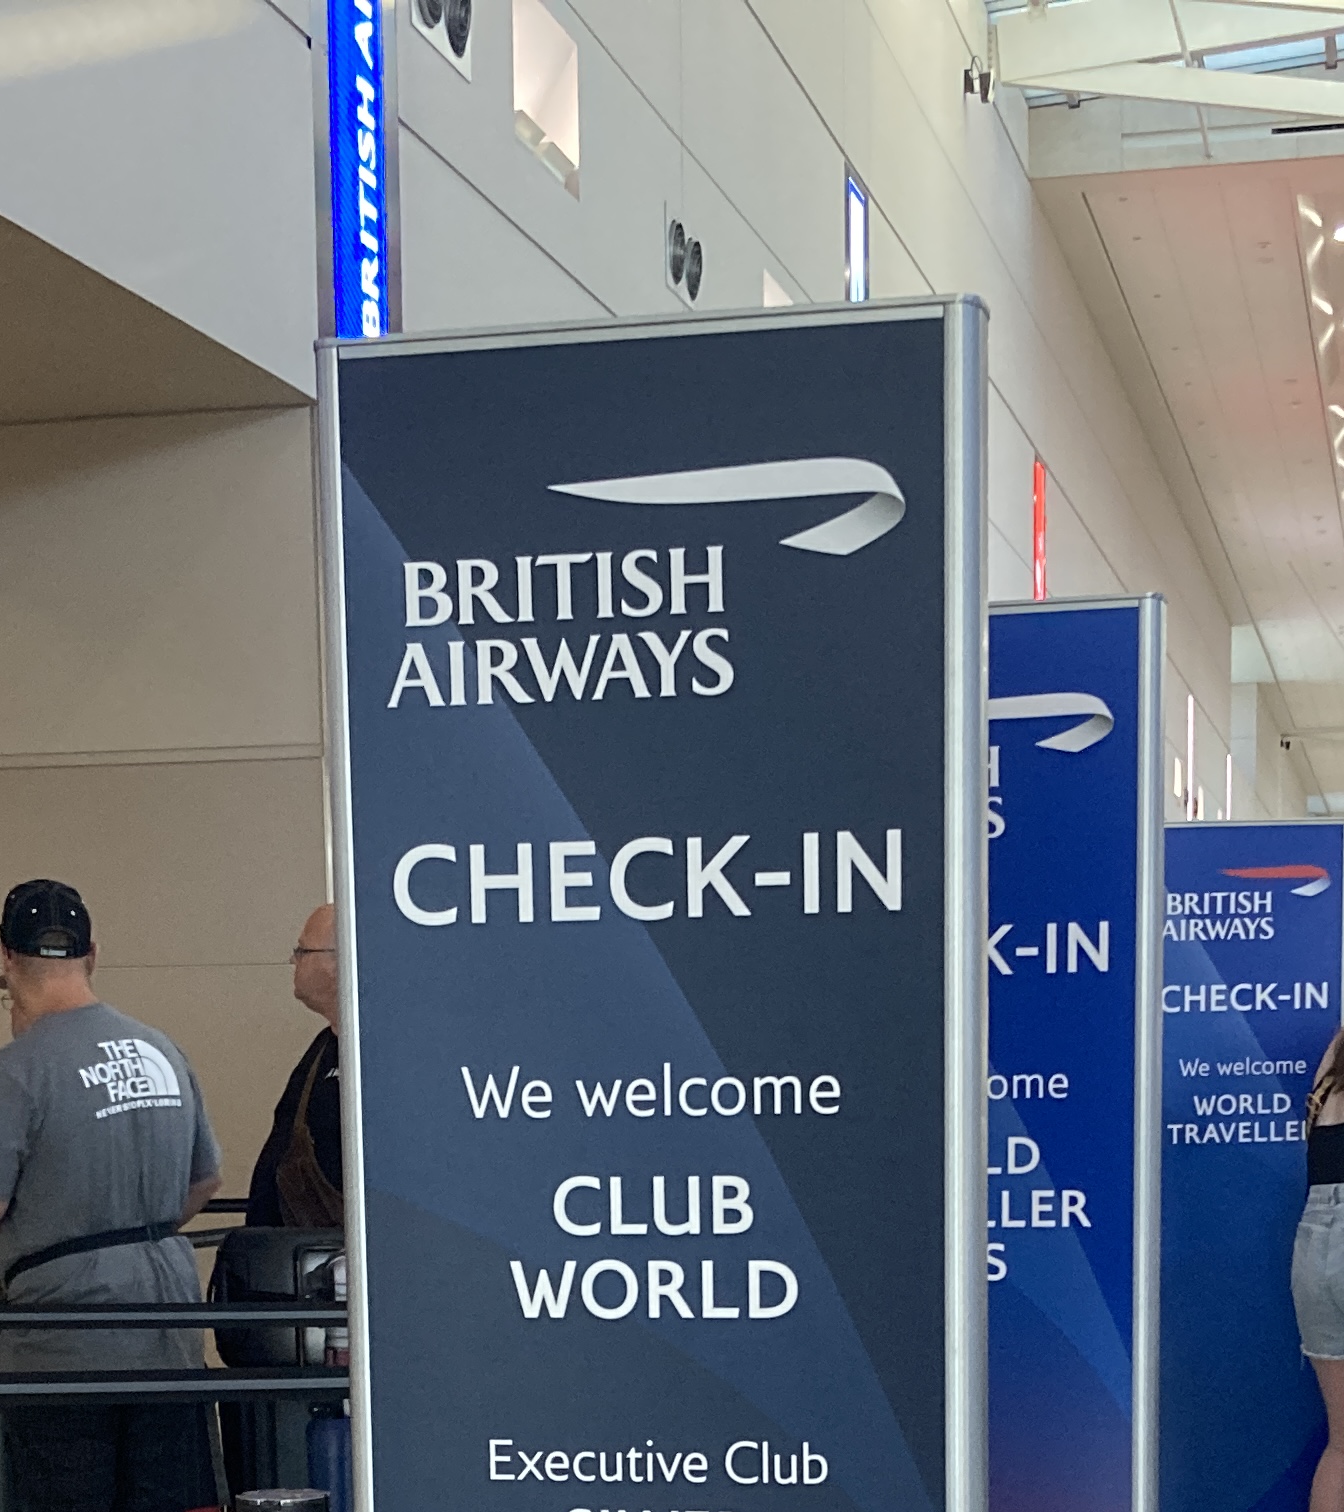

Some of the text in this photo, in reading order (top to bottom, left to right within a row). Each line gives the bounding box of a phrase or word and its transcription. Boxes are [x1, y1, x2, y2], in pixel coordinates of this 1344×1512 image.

[355, 73, 380, 338] BRITISH
[402, 545, 726, 627] BRITISH
[387, 628, 735, 708] AIRWAYS
[392, 829, 903, 927] CHECK-IN
[1166, 891, 1273, 915] BRITISH
[1163, 917, 1275, 941] AIRWAYS
[1162, 981, 1329, 1013] CHECK-IN
[97, 1039, 138, 1060] THE
[1179, 1056, 1307, 1077] We welcome
[78, 1057, 146, 1088] NORTH
[107, 1077, 150, 1102] FACE
[459, 1062, 842, 1119] We welcome
[1193, 1093, 1292, 1117] WORLD
[552, 1175, 755, 1237] CLUB
[509, 1259, 800, 1320] WORLD
[488, 1439, 830, 1485] Executive Club
